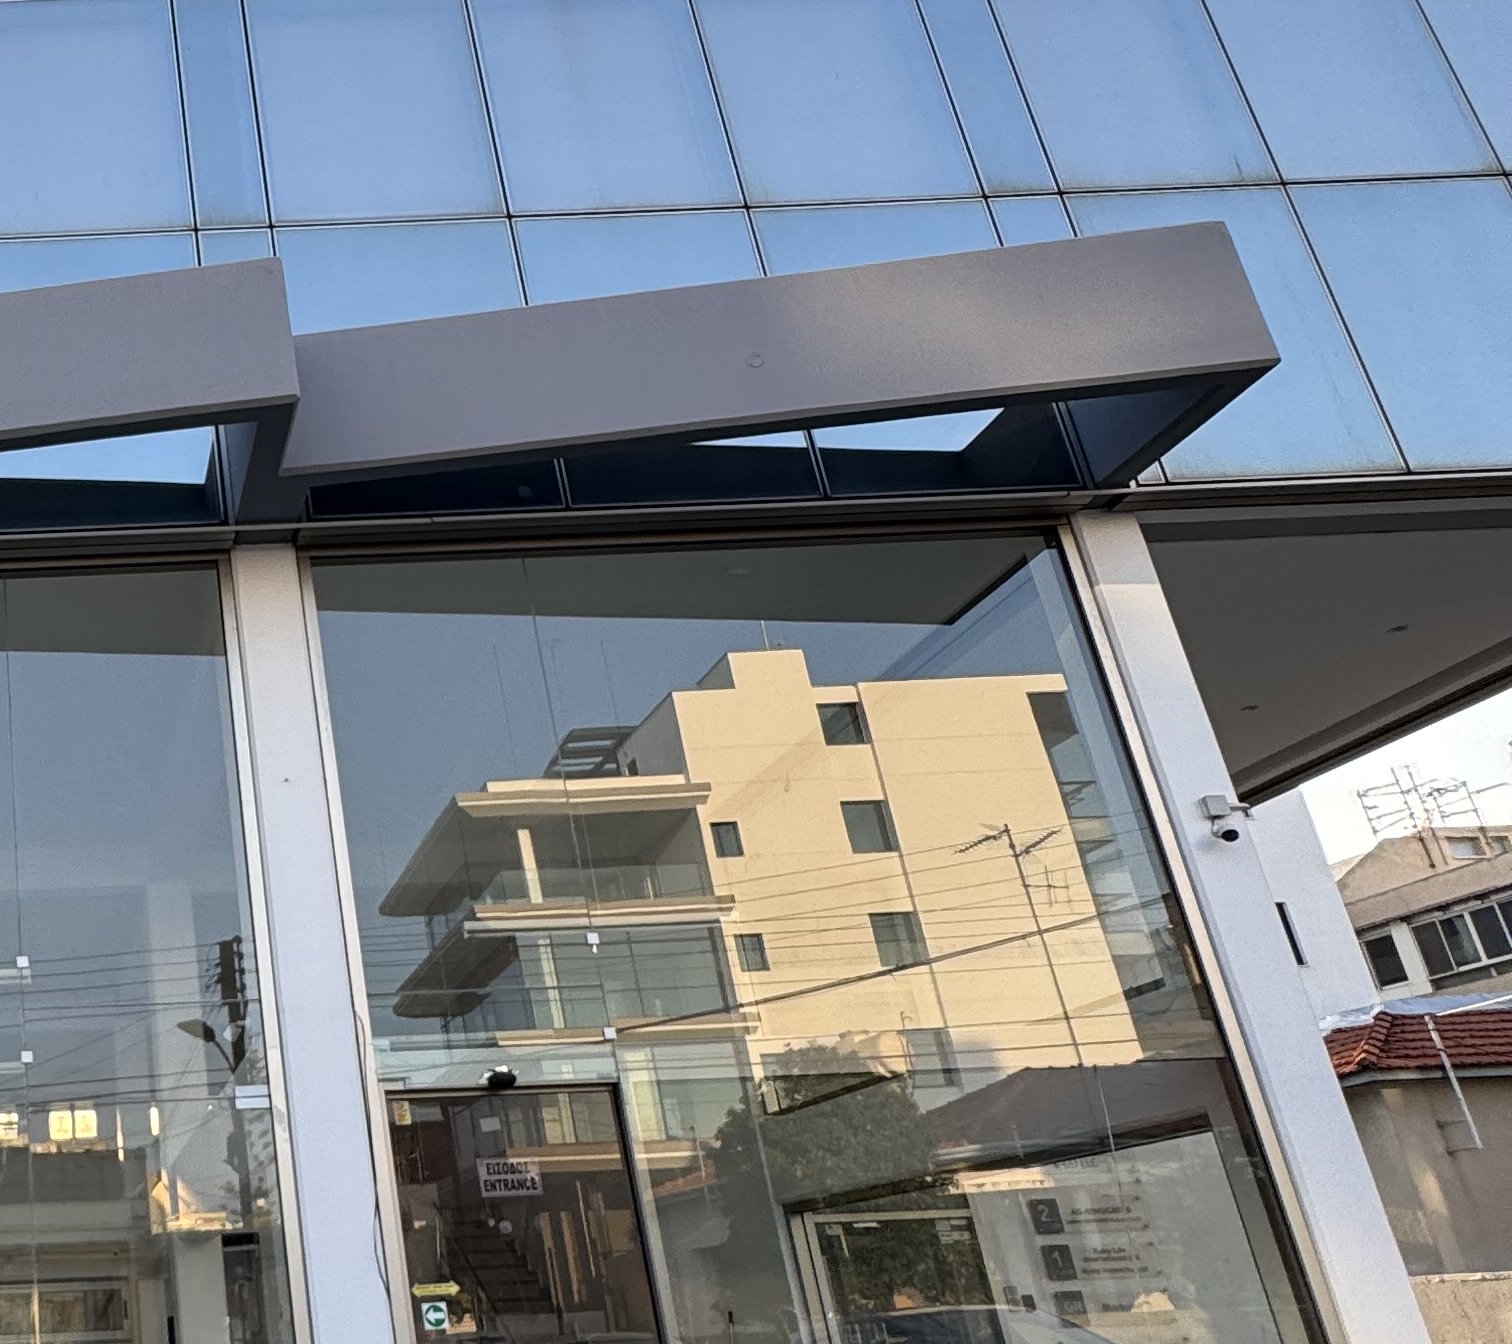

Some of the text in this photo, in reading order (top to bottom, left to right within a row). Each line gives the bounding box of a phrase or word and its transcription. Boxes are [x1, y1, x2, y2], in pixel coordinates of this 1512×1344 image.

[484, 1177, 538, 1192] ENTRANCE
[1038, 1205, 1050, 1221] 2
[1052, 1251, 1063, 1267] 1
